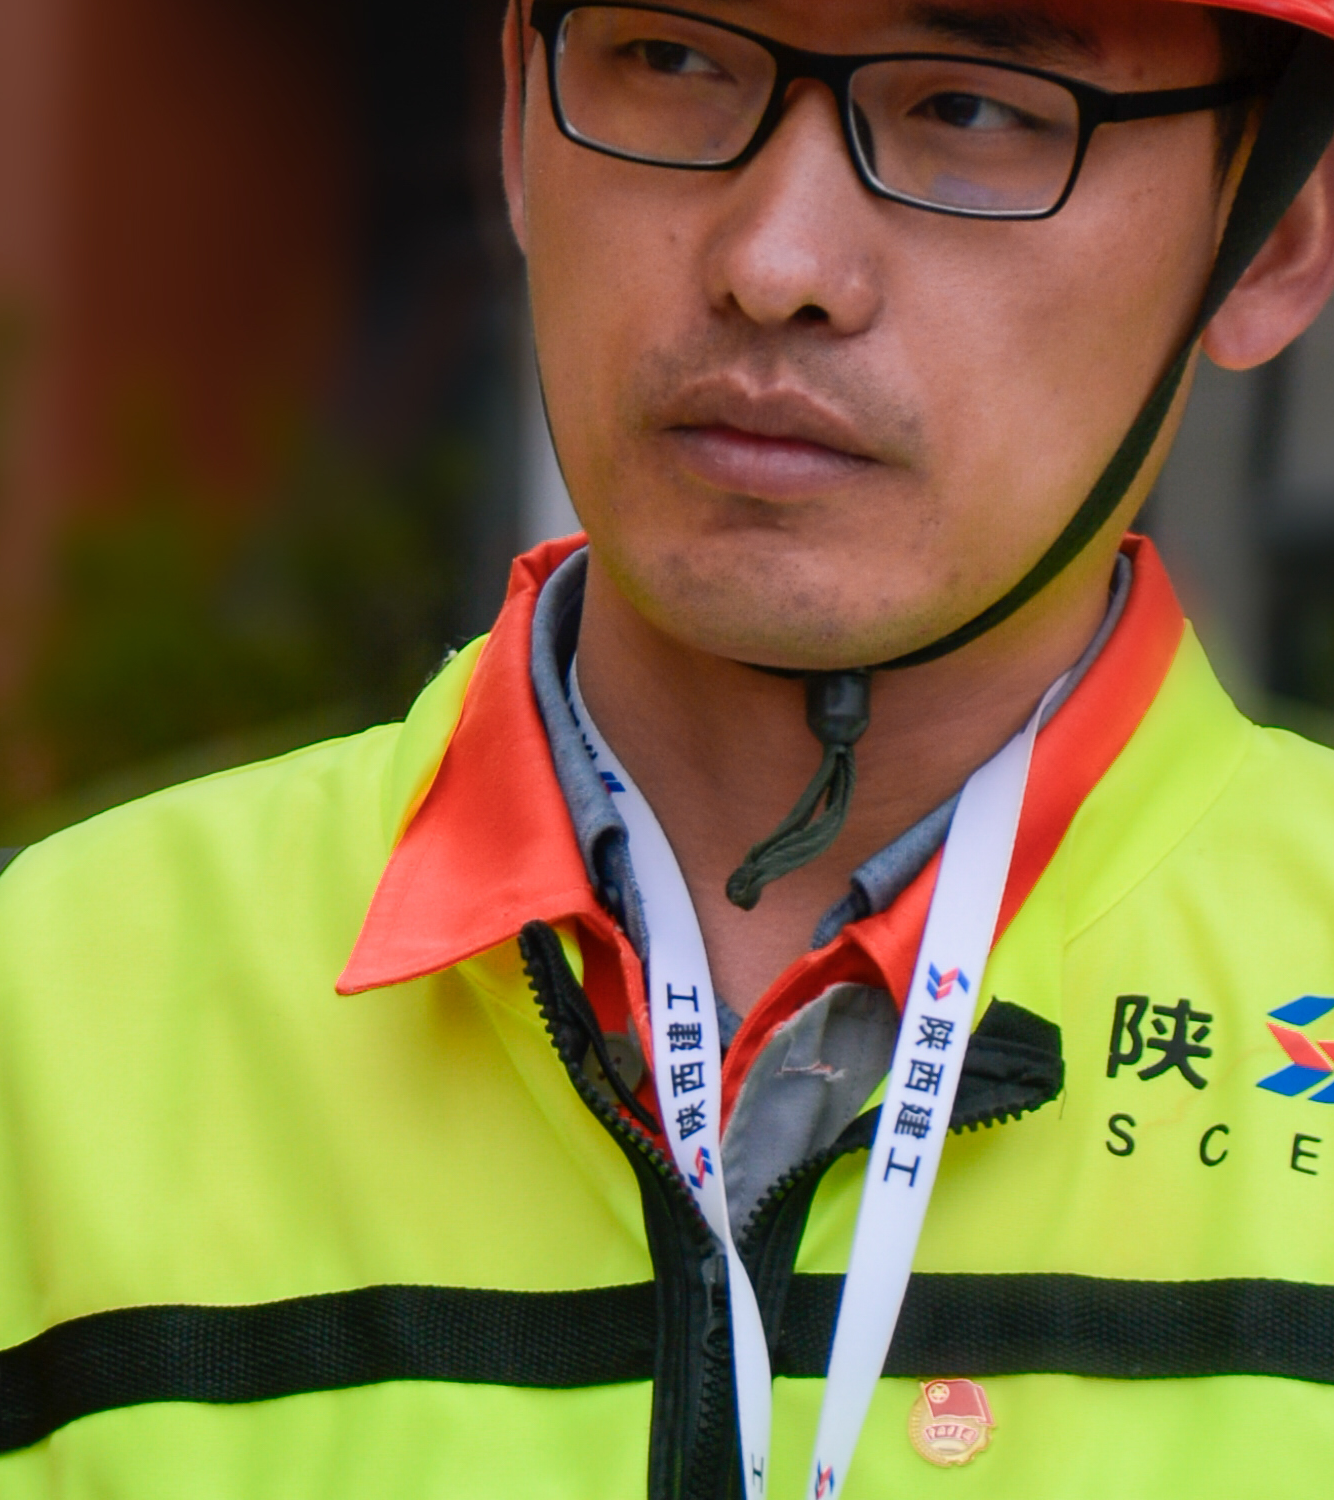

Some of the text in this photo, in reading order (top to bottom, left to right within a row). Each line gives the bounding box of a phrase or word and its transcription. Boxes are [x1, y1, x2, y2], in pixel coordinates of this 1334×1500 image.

[666, 982, 707, 1141] 陕西建工
[882, 1014, 956, 1188] 陕西建工
